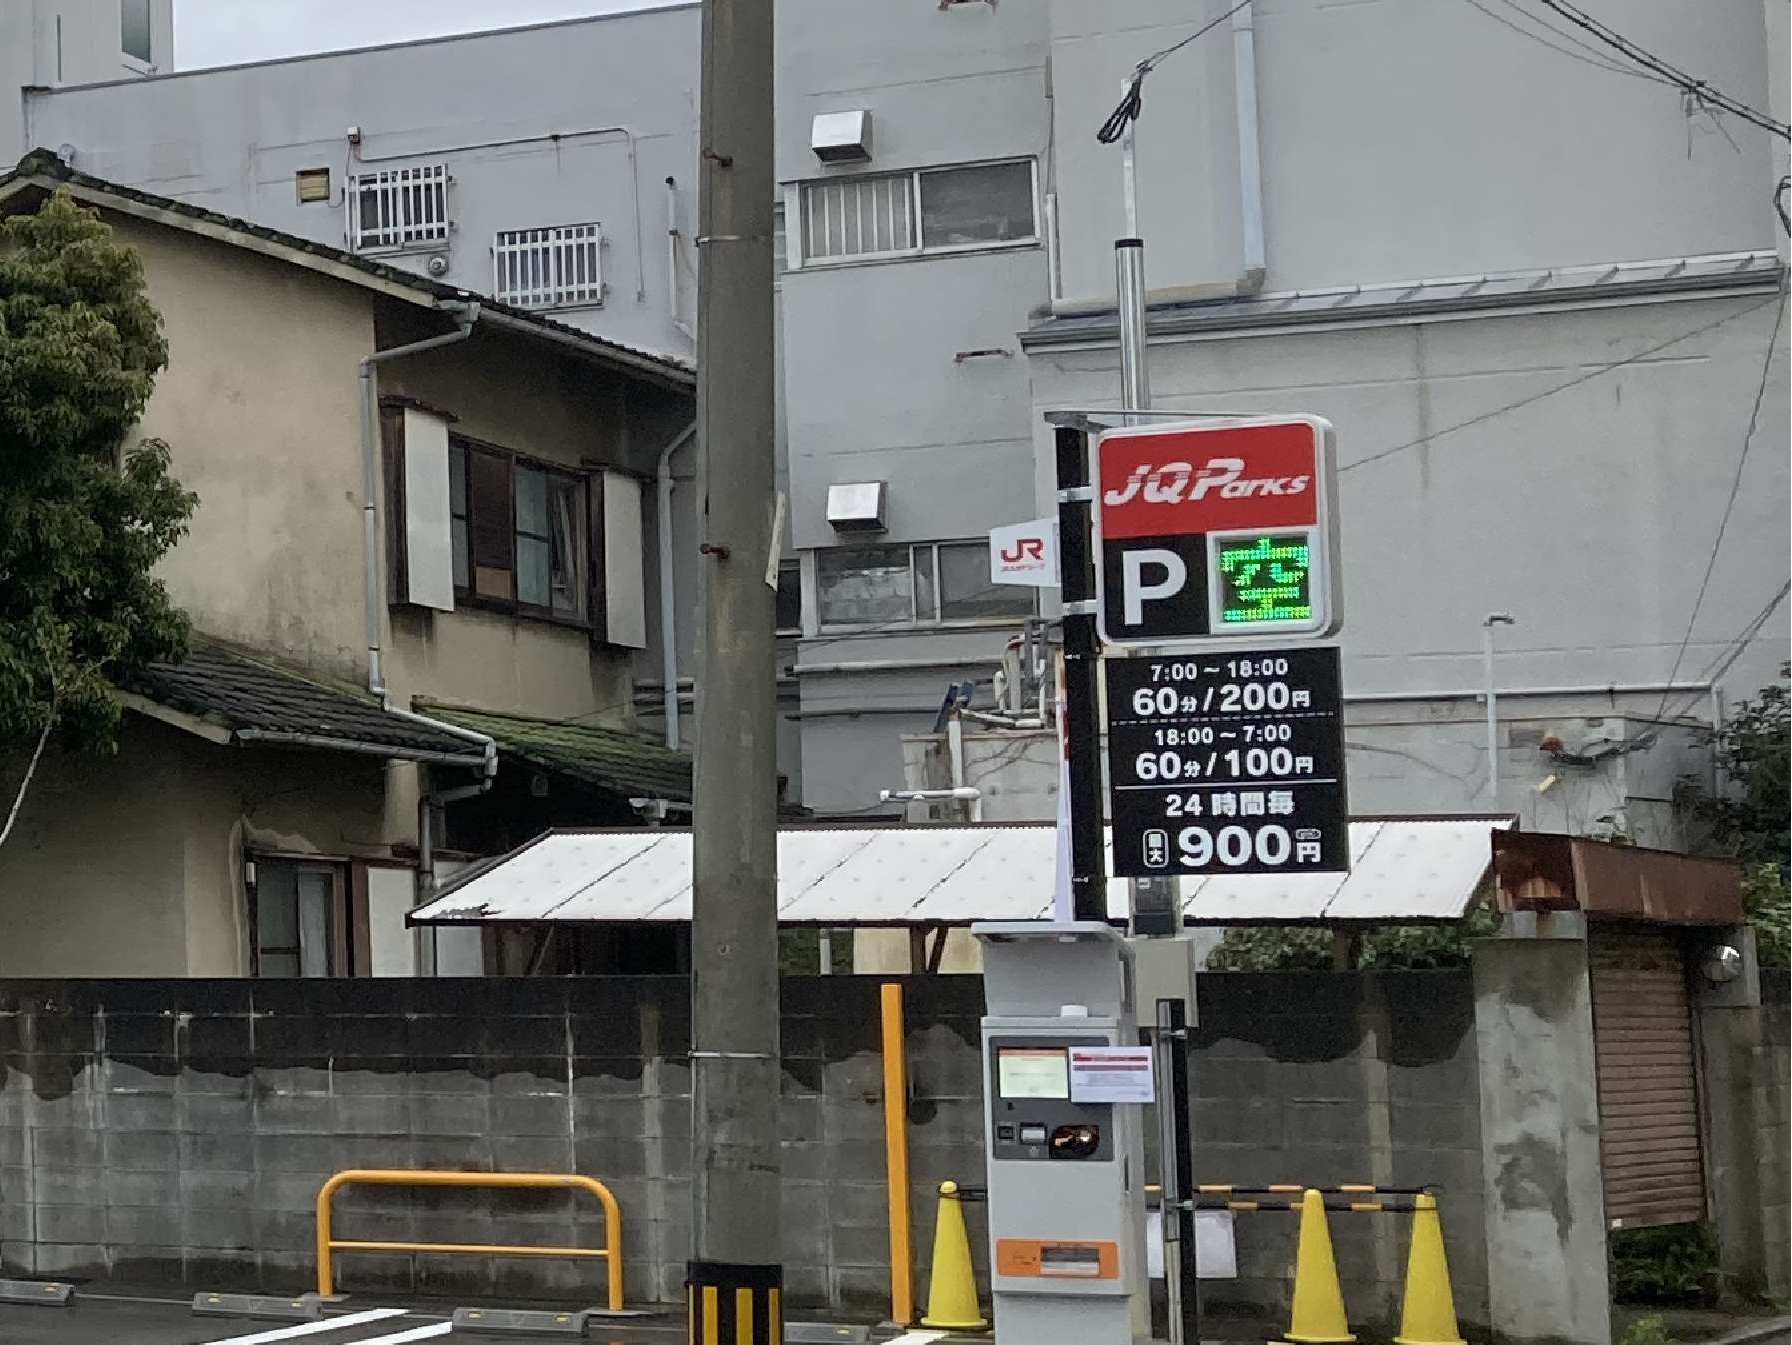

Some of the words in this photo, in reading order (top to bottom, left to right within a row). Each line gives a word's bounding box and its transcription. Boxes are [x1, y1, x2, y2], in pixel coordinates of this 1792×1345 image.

[1000, 538, 1043, 563] JR
[1220, 536, 1312, 622] 空
[1122, 549, 1188, 628] P
[1178, 824, 1322, 867] 900円
